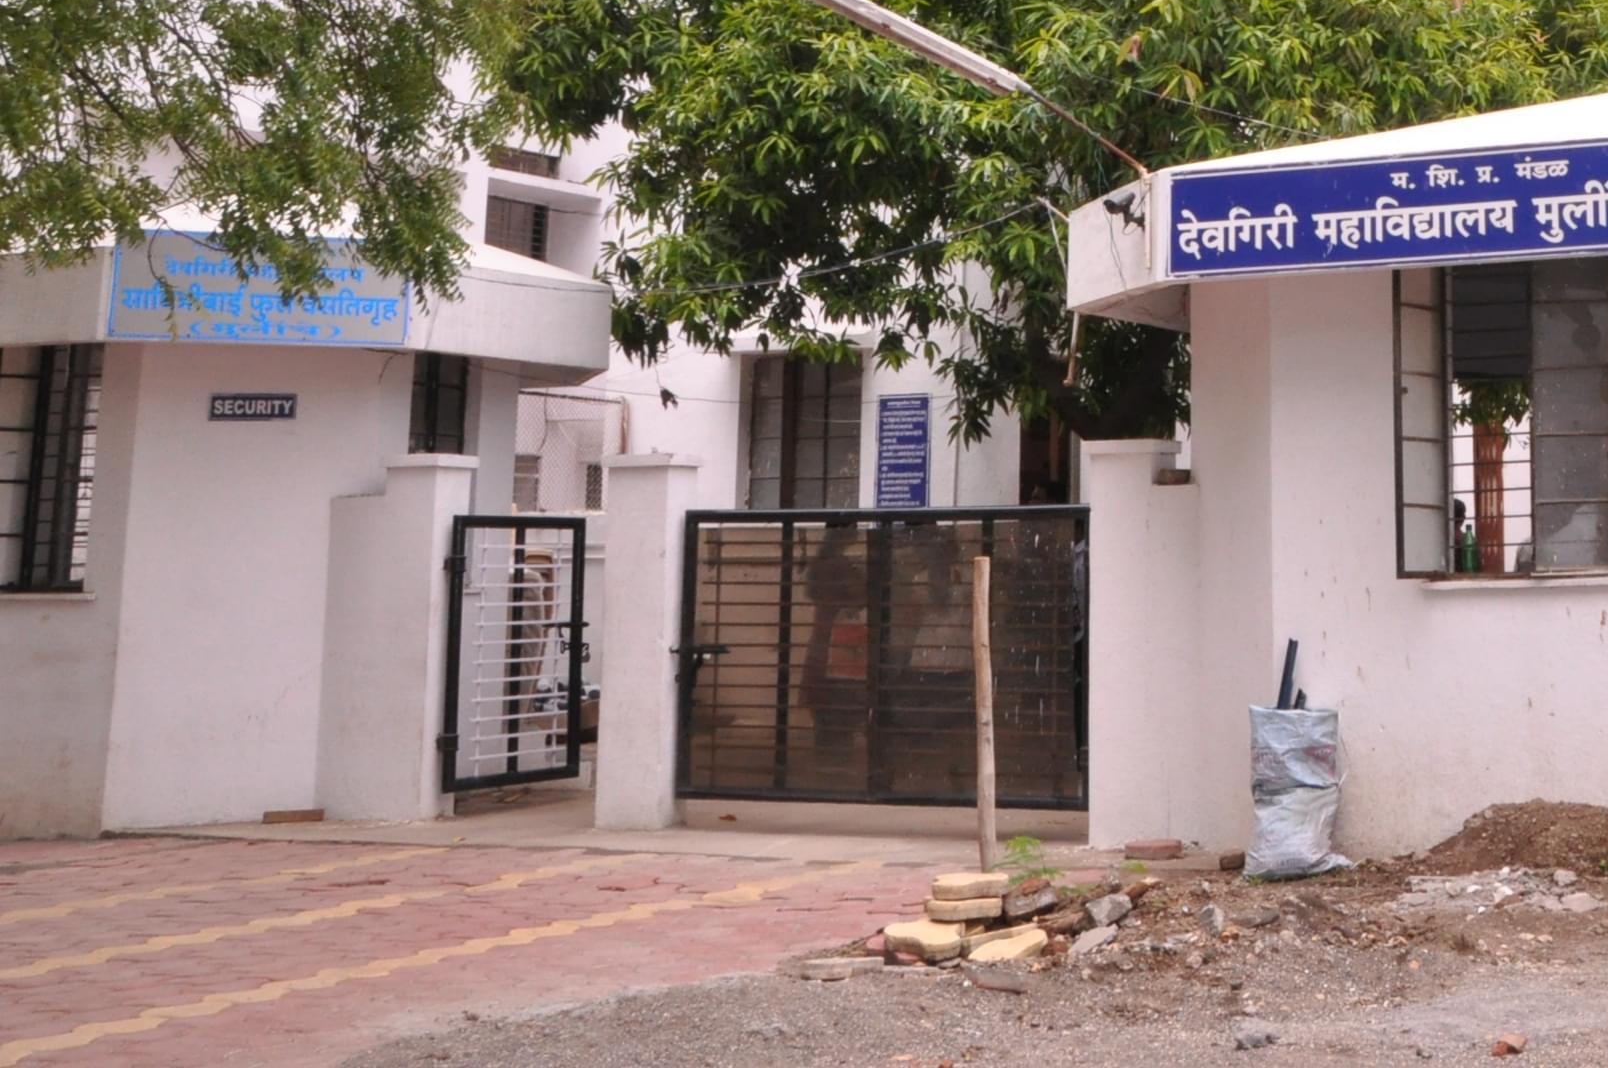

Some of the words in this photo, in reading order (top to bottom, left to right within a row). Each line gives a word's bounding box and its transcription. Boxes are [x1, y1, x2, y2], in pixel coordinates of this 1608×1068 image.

[1390, 171, 1416, 190] म.
[1426, 163, 1465, 189] शि.
[1475, 165, 1500, 185] प्र.
[1513, 155, 1570, 181] मंडळ
[1177, 202, 1298, 260] देवगिरी
[1312, 195, 1518, 249] महाविद्यालय
[213, 399, 294, 415] SECURITY
